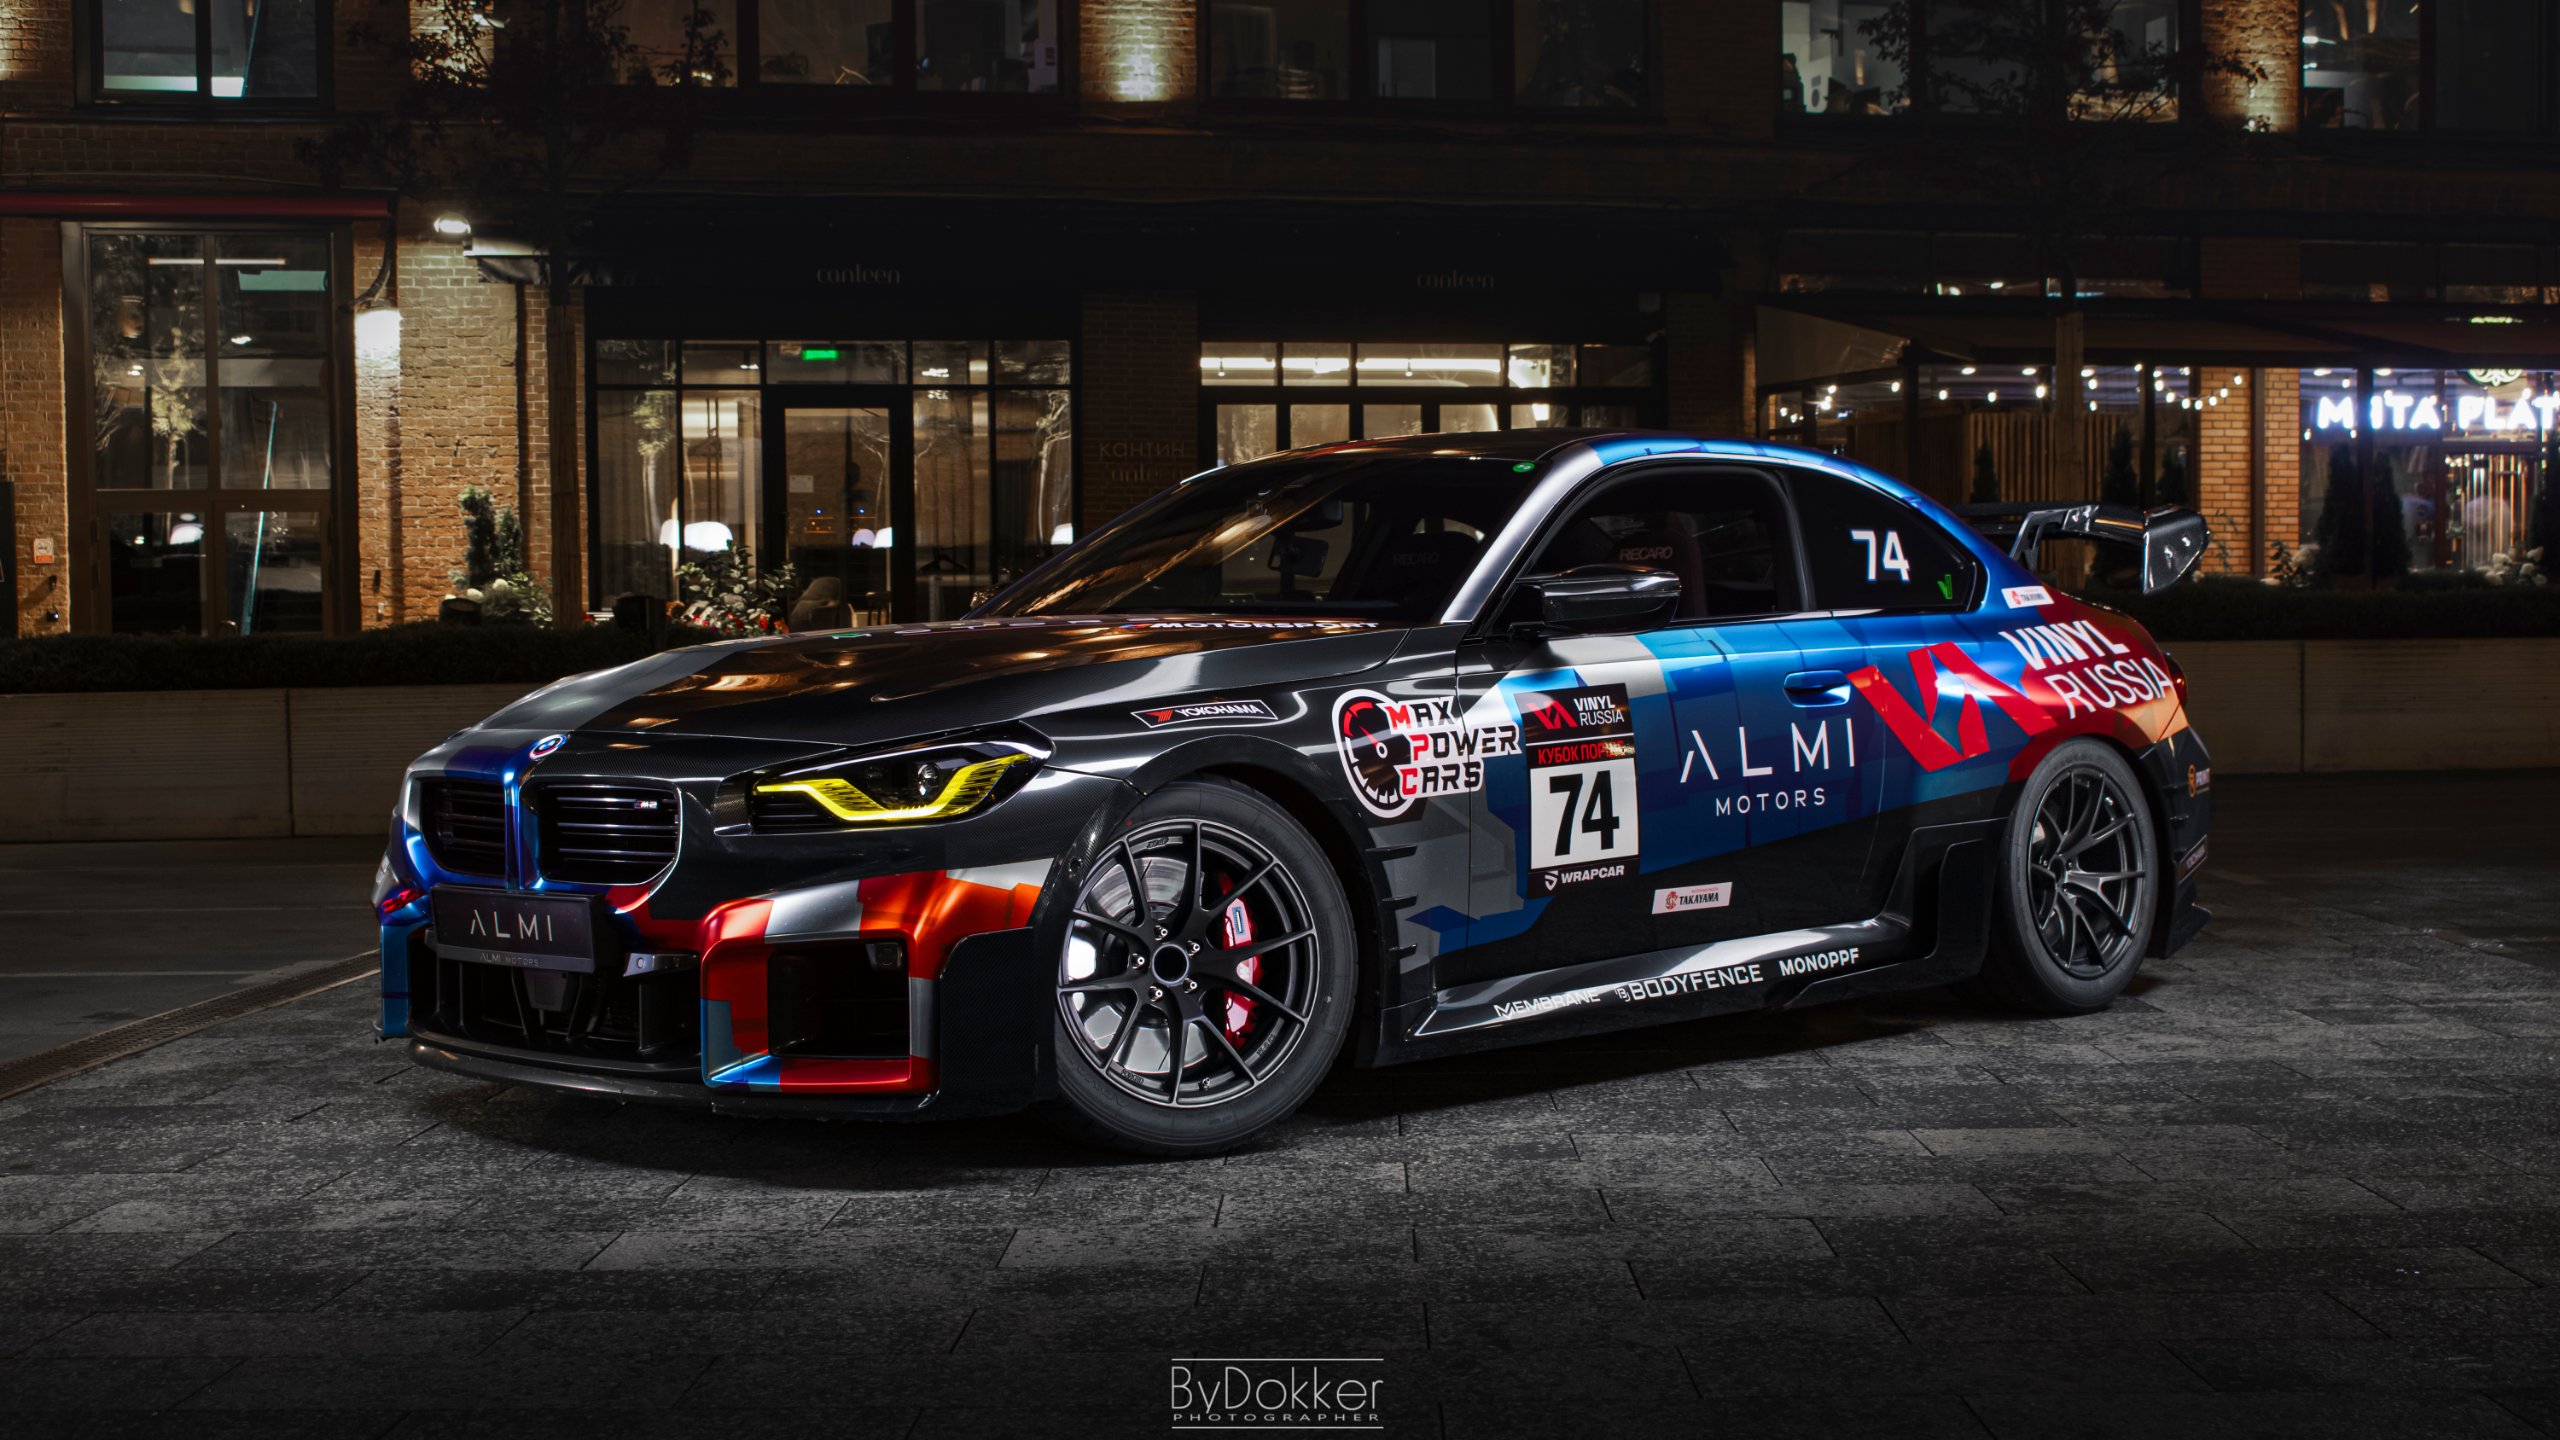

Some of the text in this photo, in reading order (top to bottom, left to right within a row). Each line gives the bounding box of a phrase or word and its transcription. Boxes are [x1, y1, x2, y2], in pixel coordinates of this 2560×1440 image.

[816, 263, 901, 285] canteen
[1416, 269, 1495, 290] canteen
[1619, 546, 1674, 561] RECARO
[1851, 530, 1910, 582] 74
[1998, 620, 2131, 671] VINYL
[1573, 695, 1616, 712] VINYL
[2044, 657, 2175, 720] RUSSIA
[1174, 704, 1265, 717] YOKOHAMA
[1384, 700, 1455, 731] MAX
[1579, 709, 1625, 726] RUSSIA
[1408, 725, 1517, 761] POWER
[1537, 745, 1580, 765] КУБОК
[1680, 718, 1855, 784] ALMI
[1400, 761, 1482, 795] CARS
[1549, 770, 1620, 857] 74
[1716, 788, 1826, 817] MOTORS
[1561, 865, 1625, 884] WRAPCAR
[1679, 892, 1719, 906] TAKAYAMA
[470, 909, 553, 942] ALMI
[480, 952, 540, 967] ALMI MOTORS
[1779, 947, 1860, 977] MONOPPF
[1628, 964, 1764, 1001] BODYFENCE
[1494, 989, 1601, 1020] MEMBRANE
